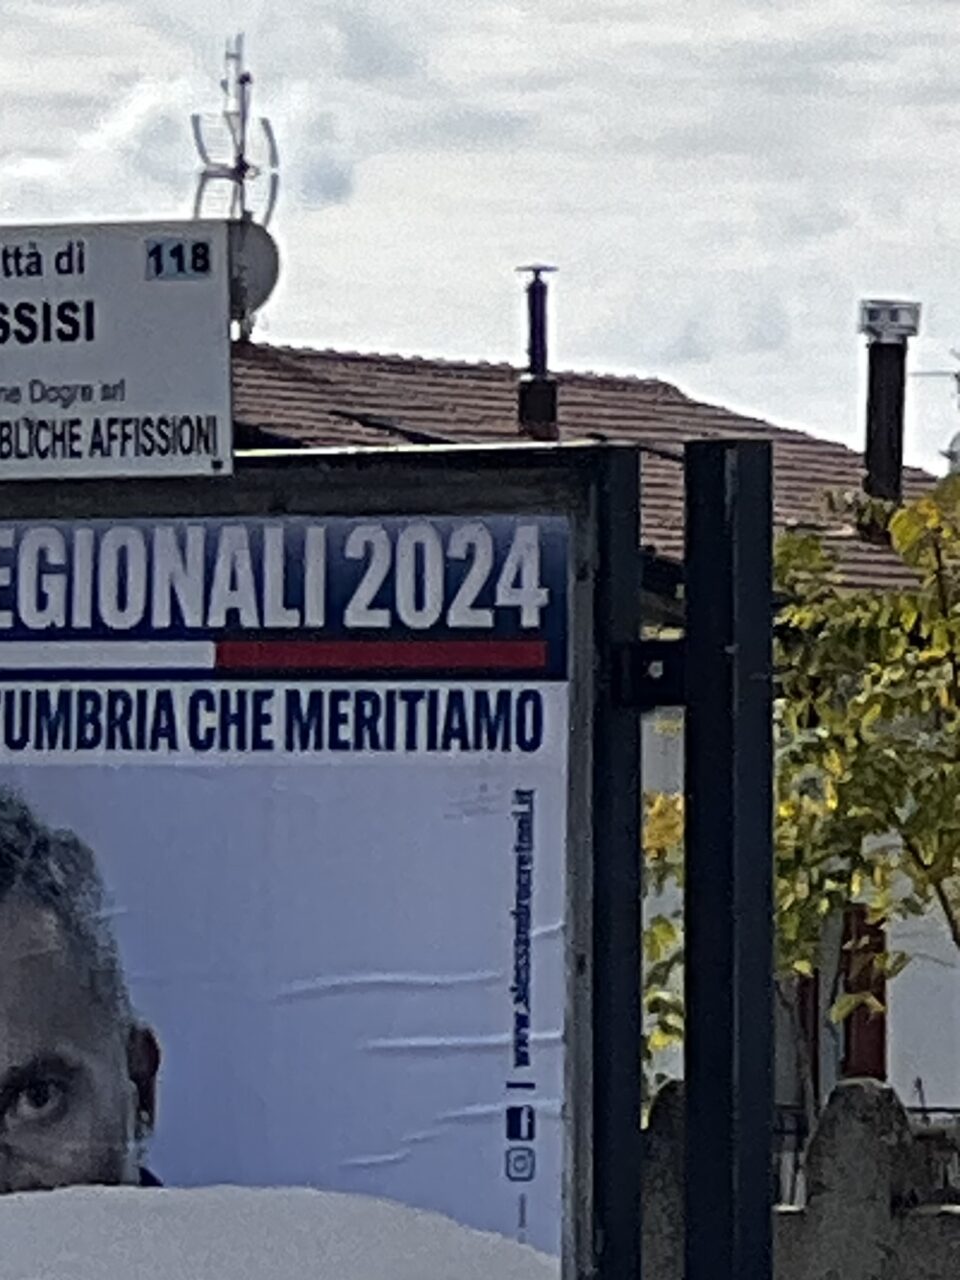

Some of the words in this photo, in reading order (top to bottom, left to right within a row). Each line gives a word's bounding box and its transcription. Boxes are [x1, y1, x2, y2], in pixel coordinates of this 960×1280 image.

[54, 241, 86, 275] di
[148, 242, 211, 276] 118
[89, 414, 218, 458] AFFISSIONI
[342, 522, 548, 629] 2024
[187, 688, 273, 752] CHE
[283, 687, 544, 753] MERITIAMO
